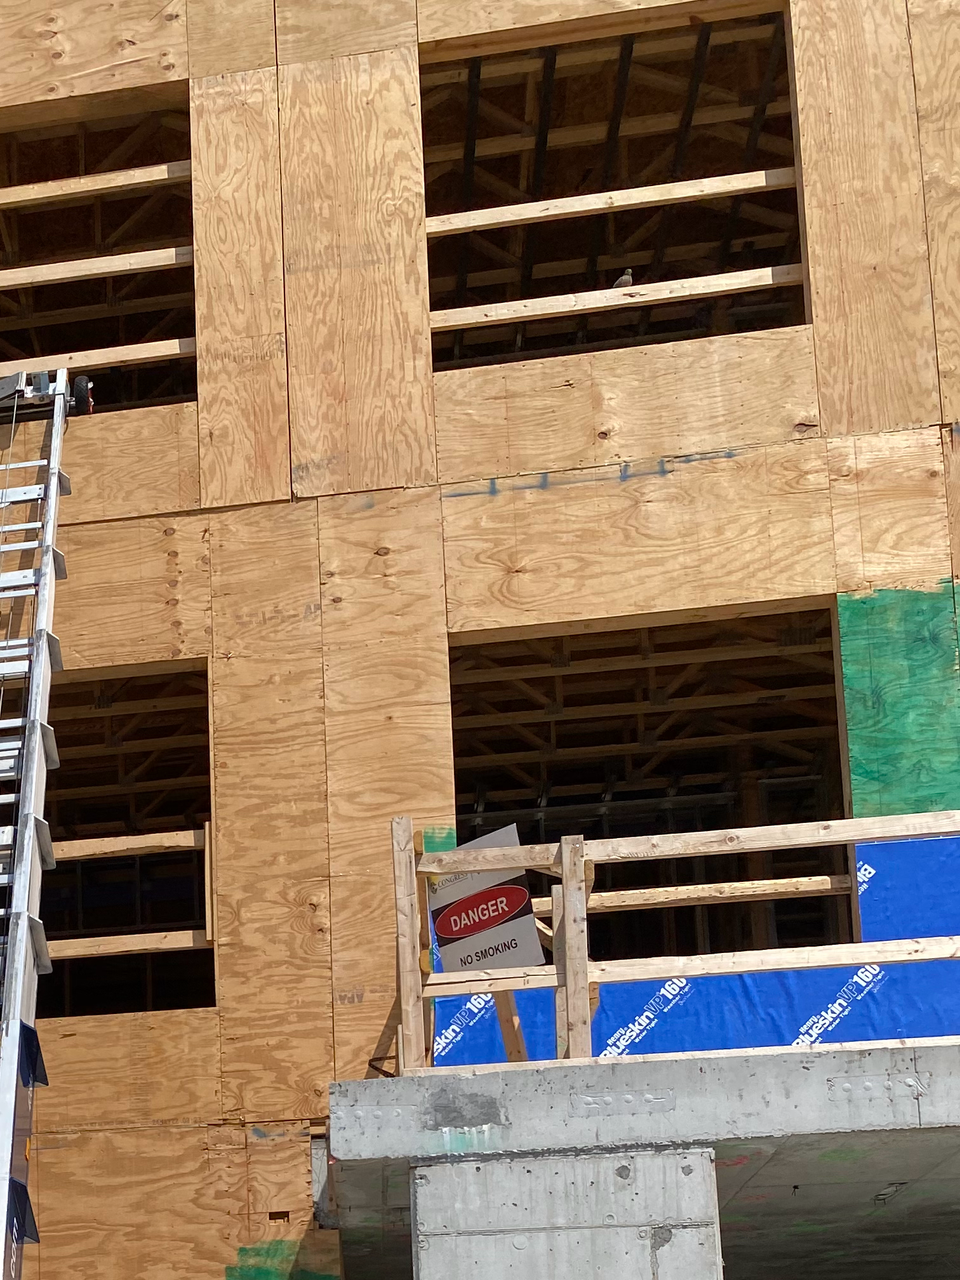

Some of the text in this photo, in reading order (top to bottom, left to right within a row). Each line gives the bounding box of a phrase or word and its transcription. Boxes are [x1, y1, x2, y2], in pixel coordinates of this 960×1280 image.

[450, 896, 509, 931] DANGER
[459, 938, 518, 967] NO SMOKING
